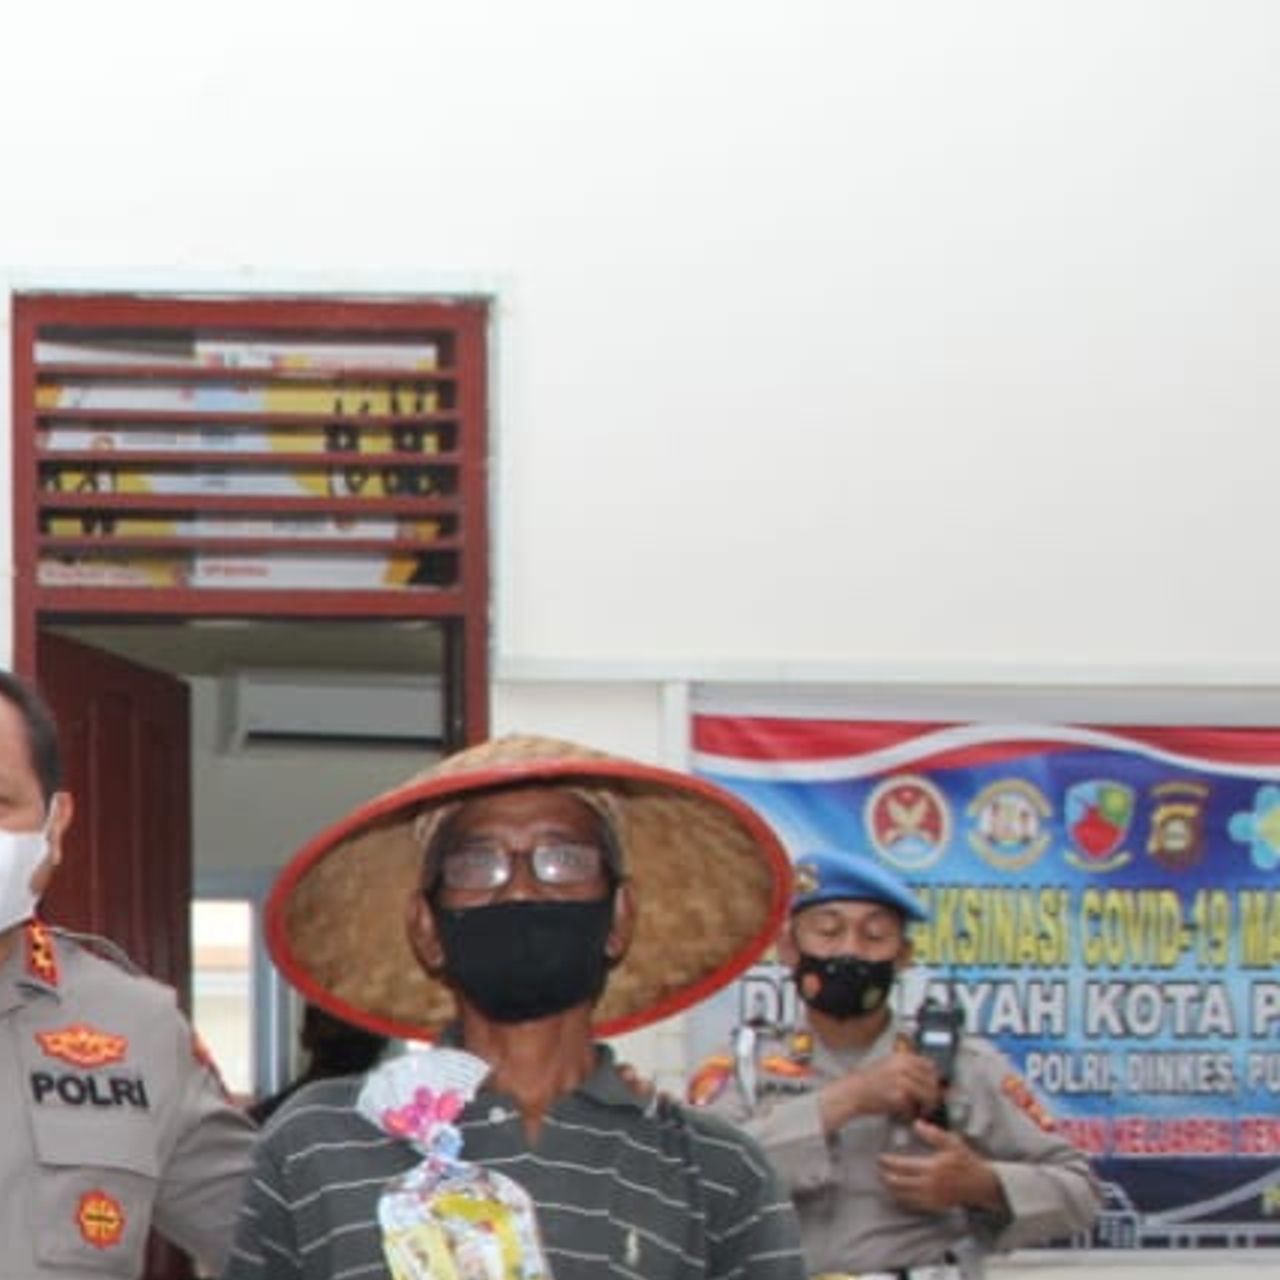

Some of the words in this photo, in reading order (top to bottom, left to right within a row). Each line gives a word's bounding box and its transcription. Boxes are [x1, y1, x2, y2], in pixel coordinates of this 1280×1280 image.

[1083, 888, 1228, 967] COVID-19
[1084, 983, 1236, 1035] KOTA
[31, 1071, 151, 1110] POLRI
